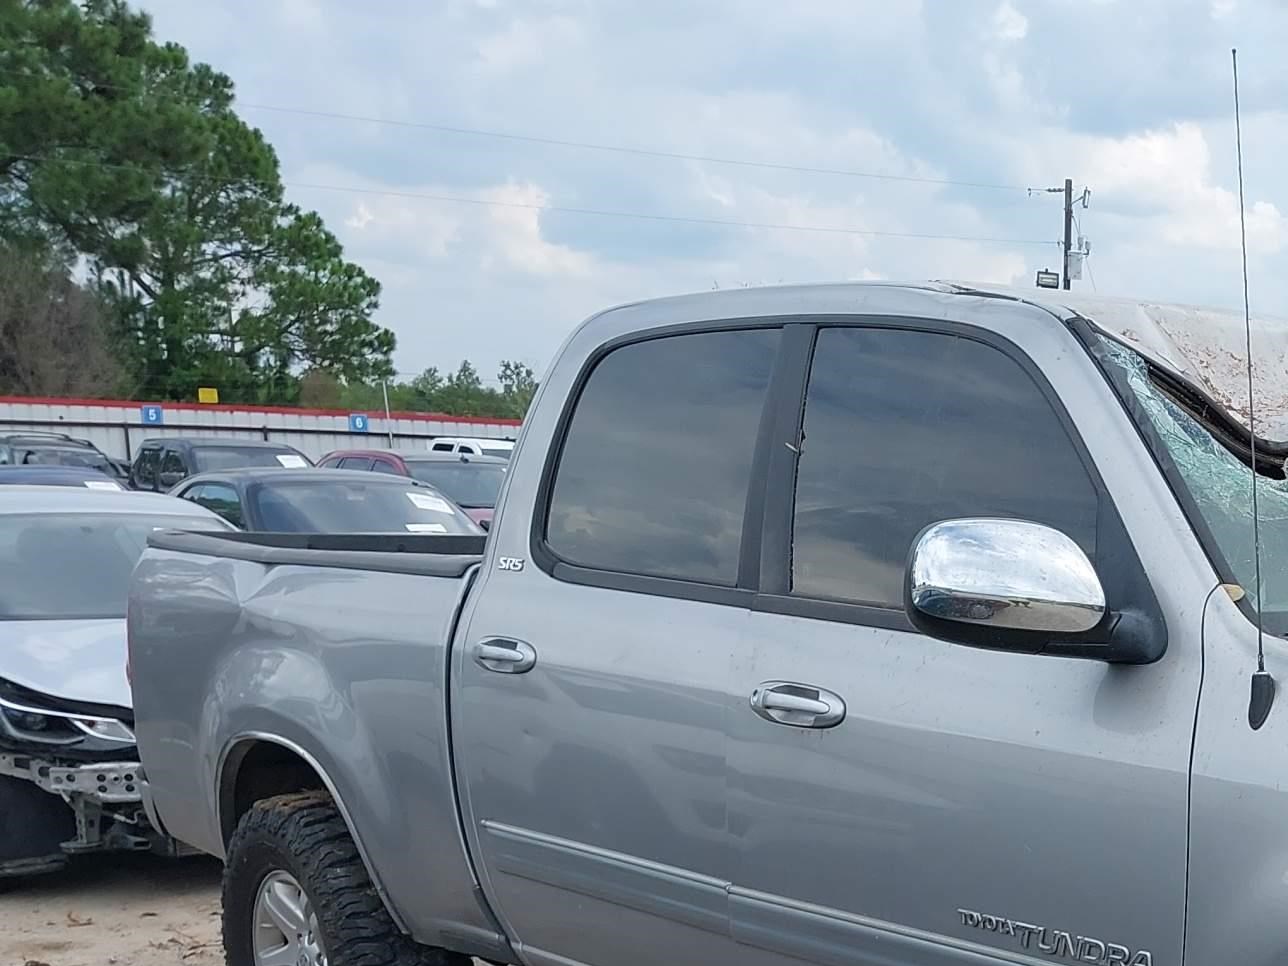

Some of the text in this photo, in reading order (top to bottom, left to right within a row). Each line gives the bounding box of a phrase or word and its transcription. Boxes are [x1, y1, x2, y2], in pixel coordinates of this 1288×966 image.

[148, 408, 157, 421] 5
[355, 416, 363, 429] 6
[498, 556, 526, 572] SR5
[957, 908, 1017, 937] TOYOTA
